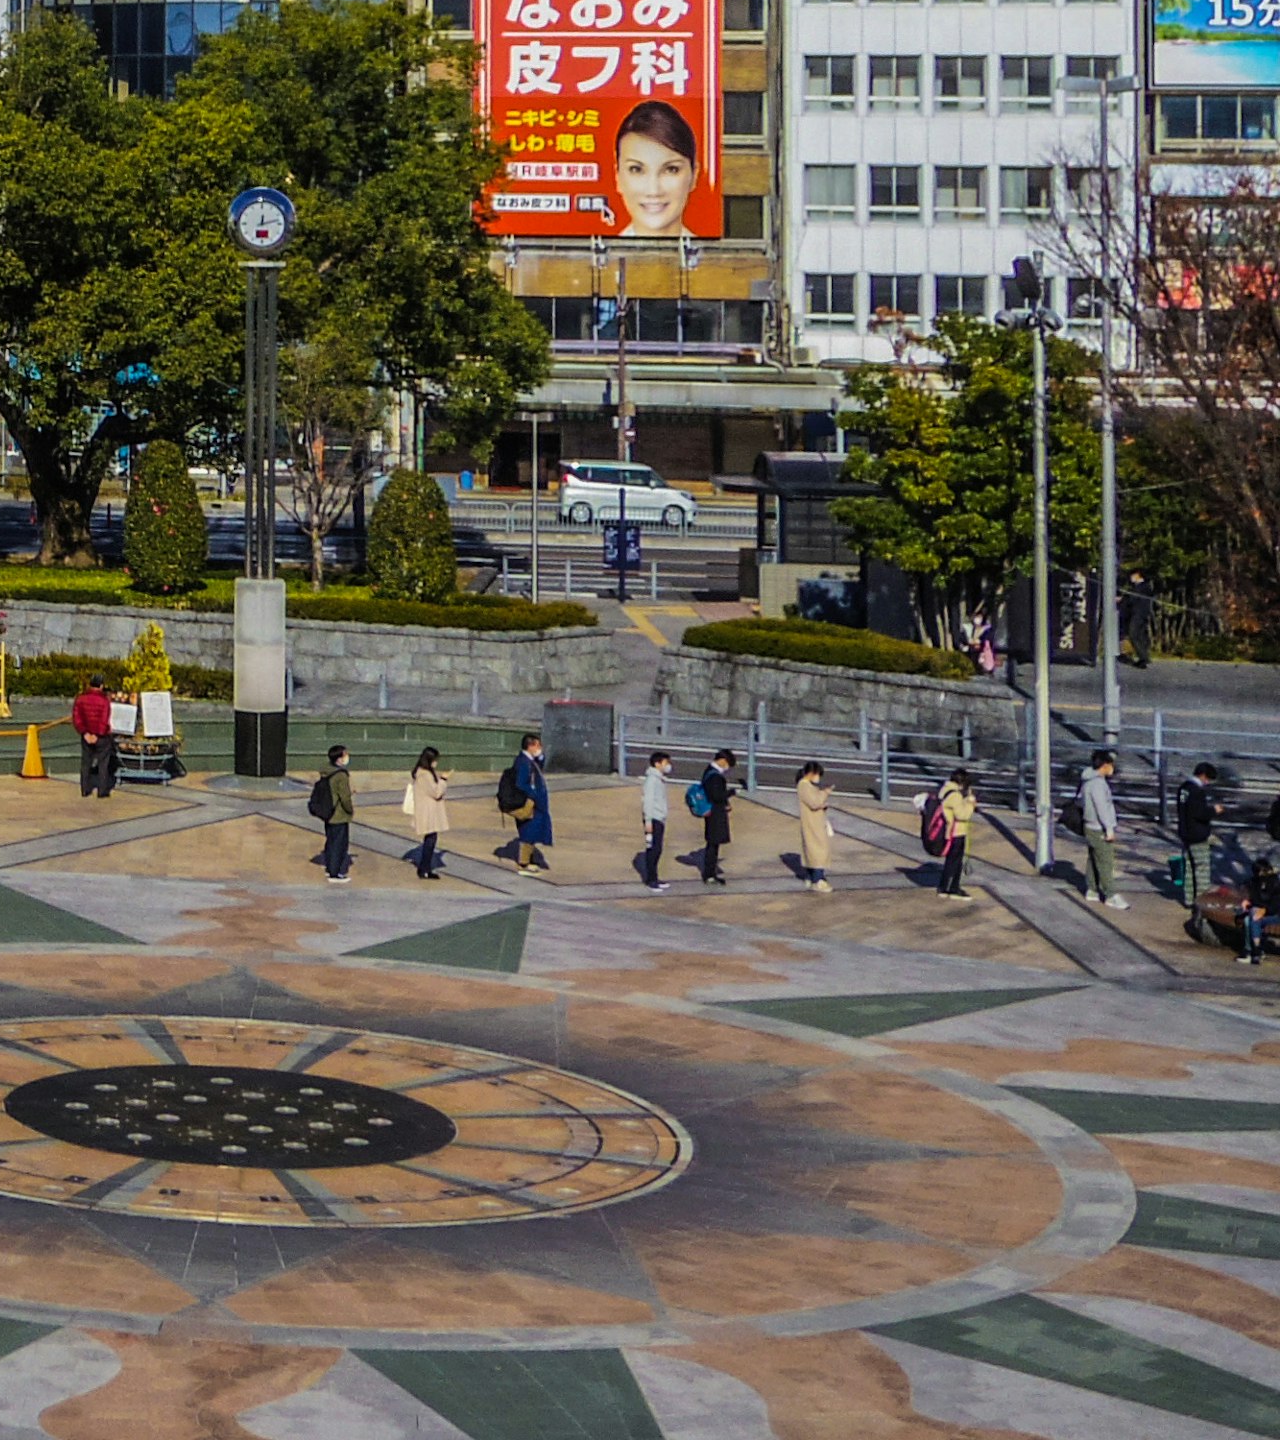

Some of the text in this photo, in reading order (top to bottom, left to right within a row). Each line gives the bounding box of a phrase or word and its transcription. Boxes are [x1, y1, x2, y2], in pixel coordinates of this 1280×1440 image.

[505, 40, 690, 96] 皮フ科
[504, 109, 600, 127] ニキビ・シミ
[510, 133, 595, 153] しわ・薄毛
